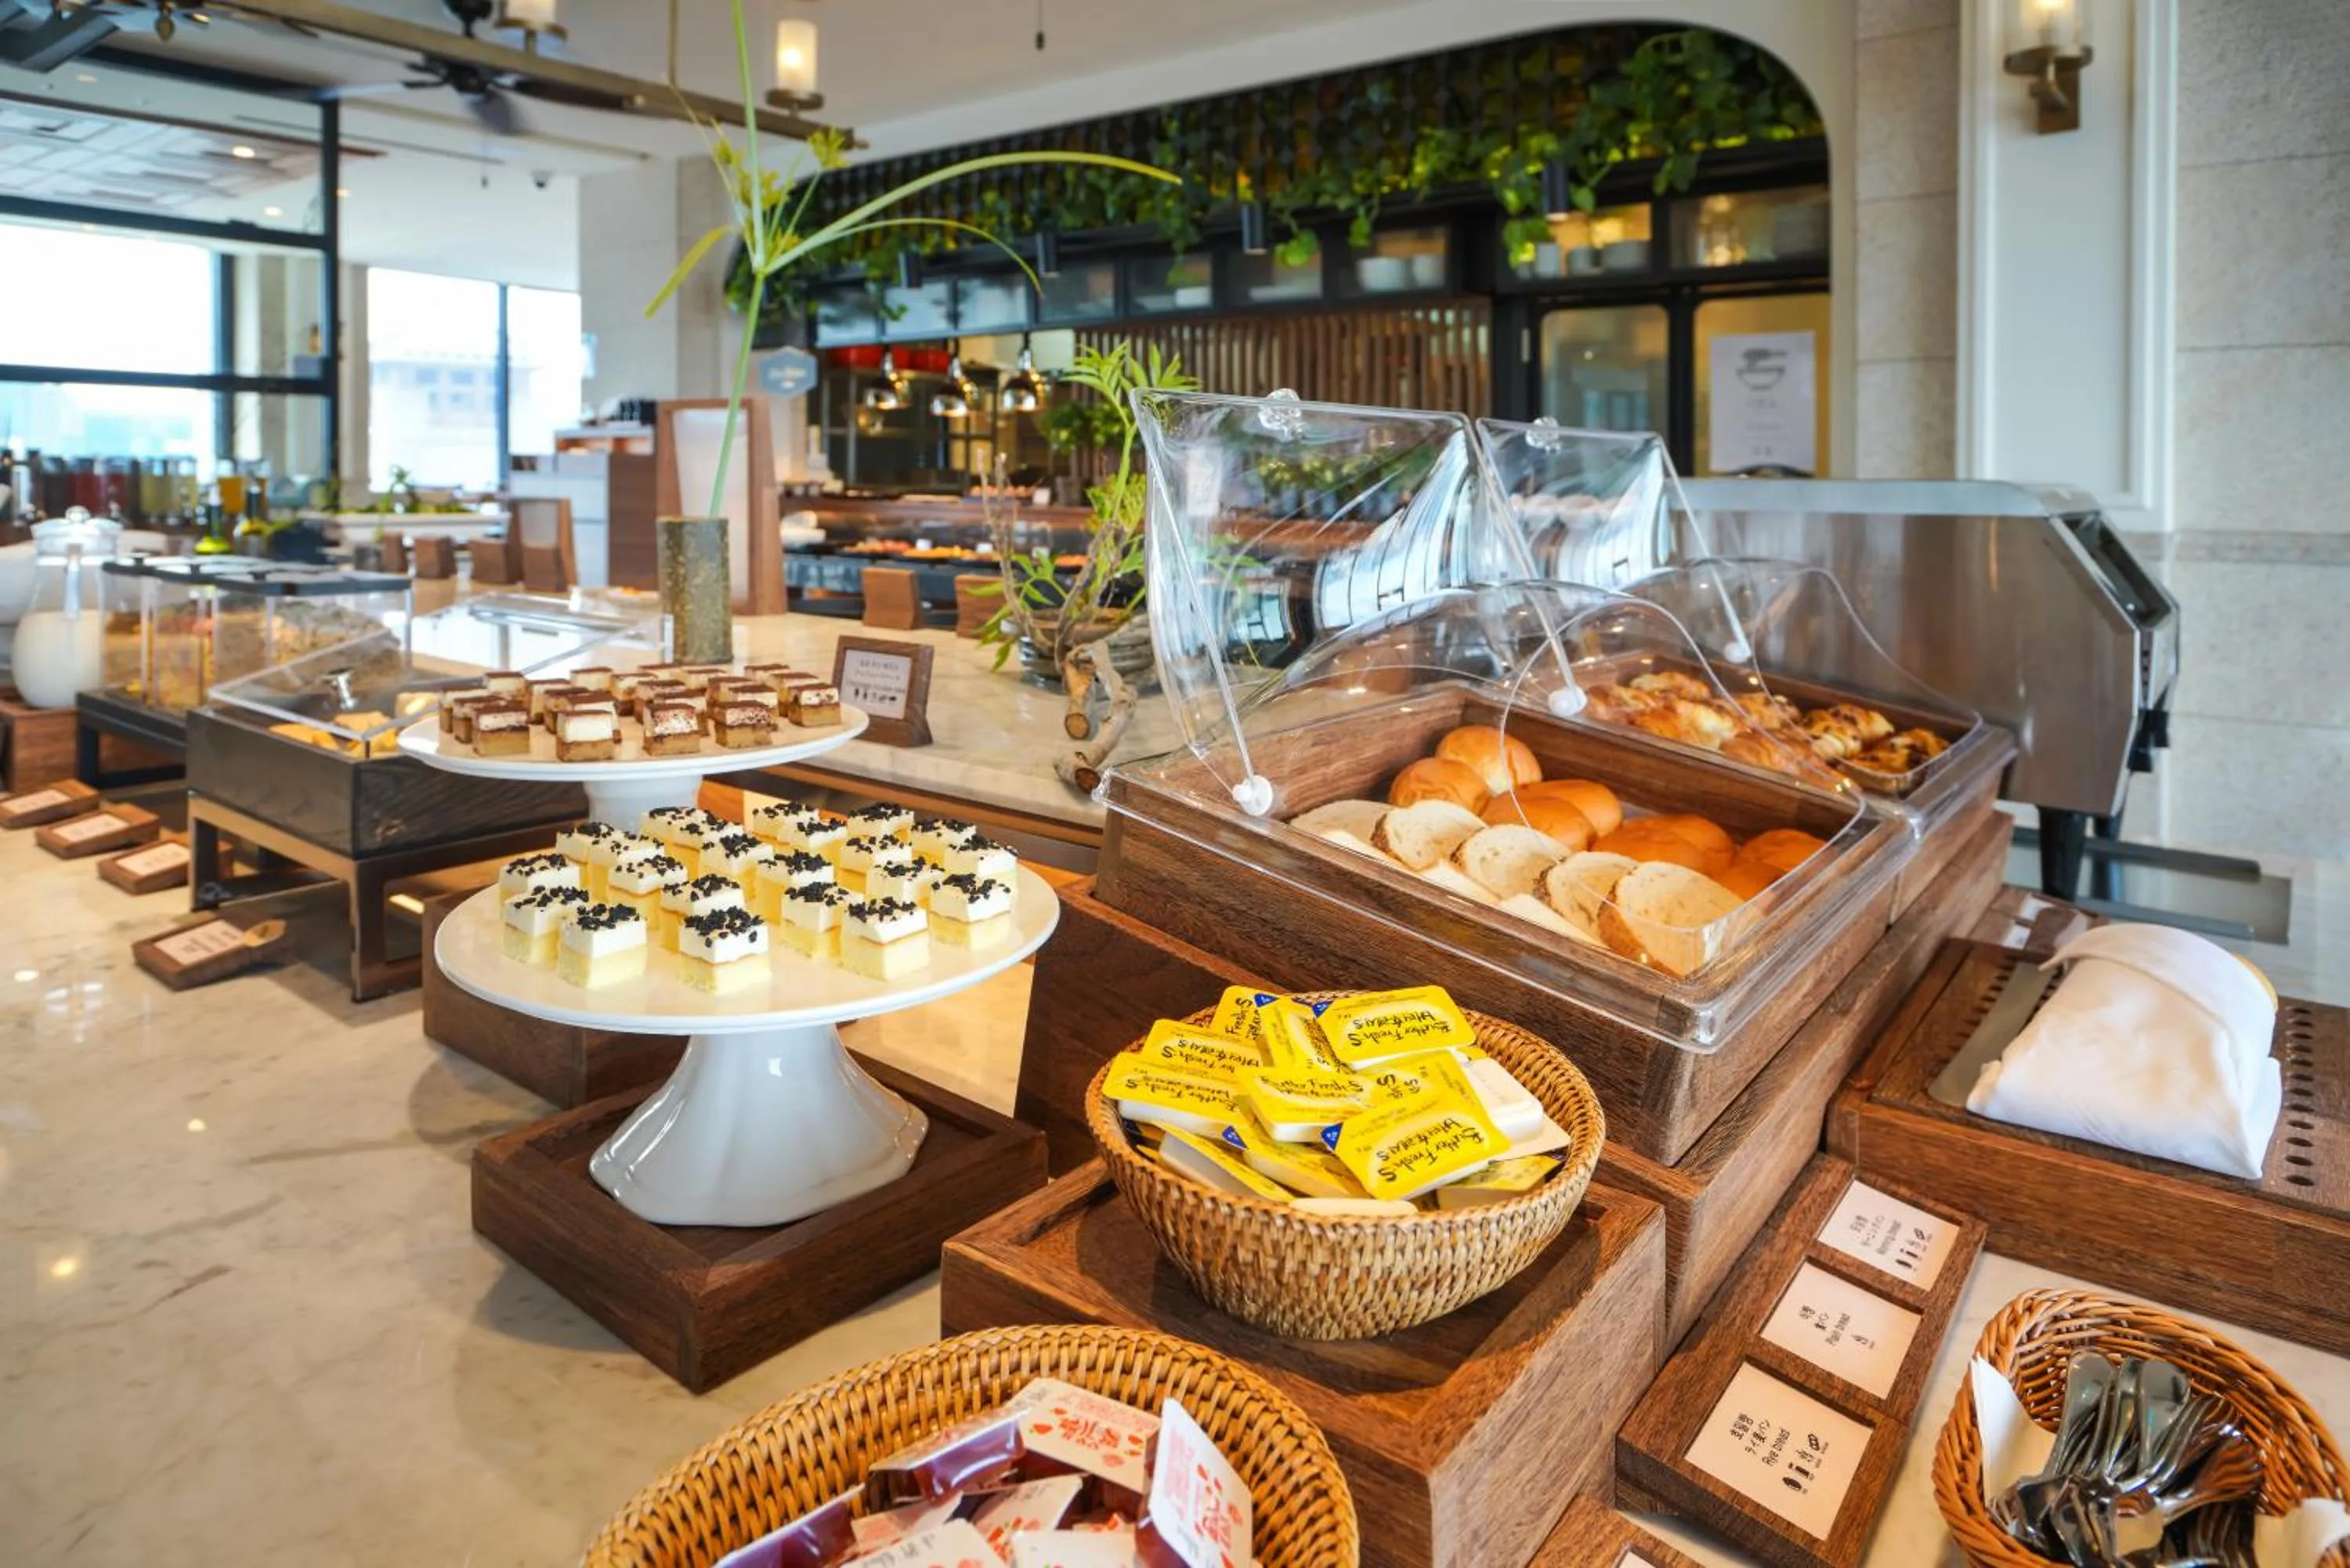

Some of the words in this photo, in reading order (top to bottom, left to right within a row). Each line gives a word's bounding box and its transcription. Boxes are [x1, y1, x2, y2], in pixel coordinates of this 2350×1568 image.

[1435, 1127, 1484, 1151] Butter
[1394, 1148, 1438, 1172] Fresh
[1762, 1450, 1779, 1466] Rye
[1772, 1427, 1790, 1451] bread
